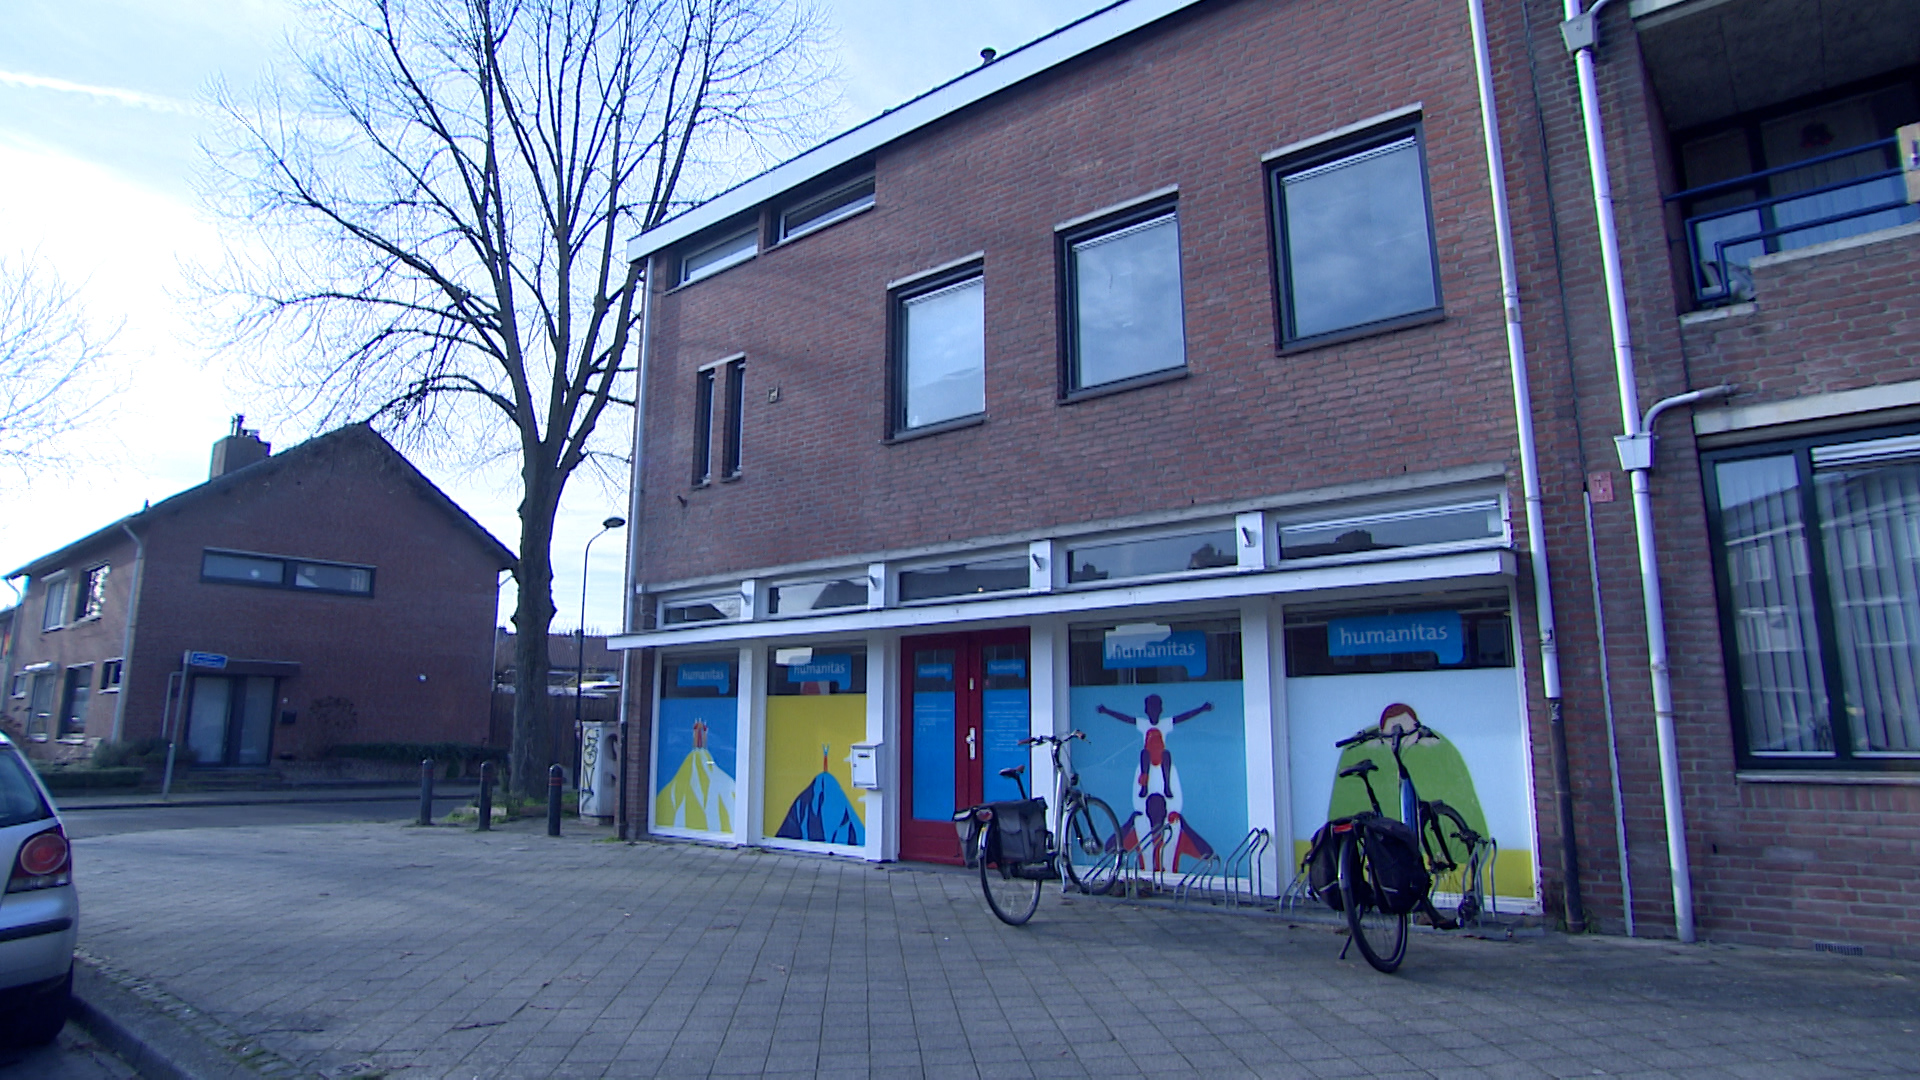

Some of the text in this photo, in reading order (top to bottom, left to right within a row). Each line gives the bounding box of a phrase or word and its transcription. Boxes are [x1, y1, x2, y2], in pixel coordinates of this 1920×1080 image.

[1340, 623, 1448, 646] humanitas
[1112, 641, 1196, 658] humanitas
[682, 669, 724, 680] humanitas
[793, 662, 846, 675] humanitas
